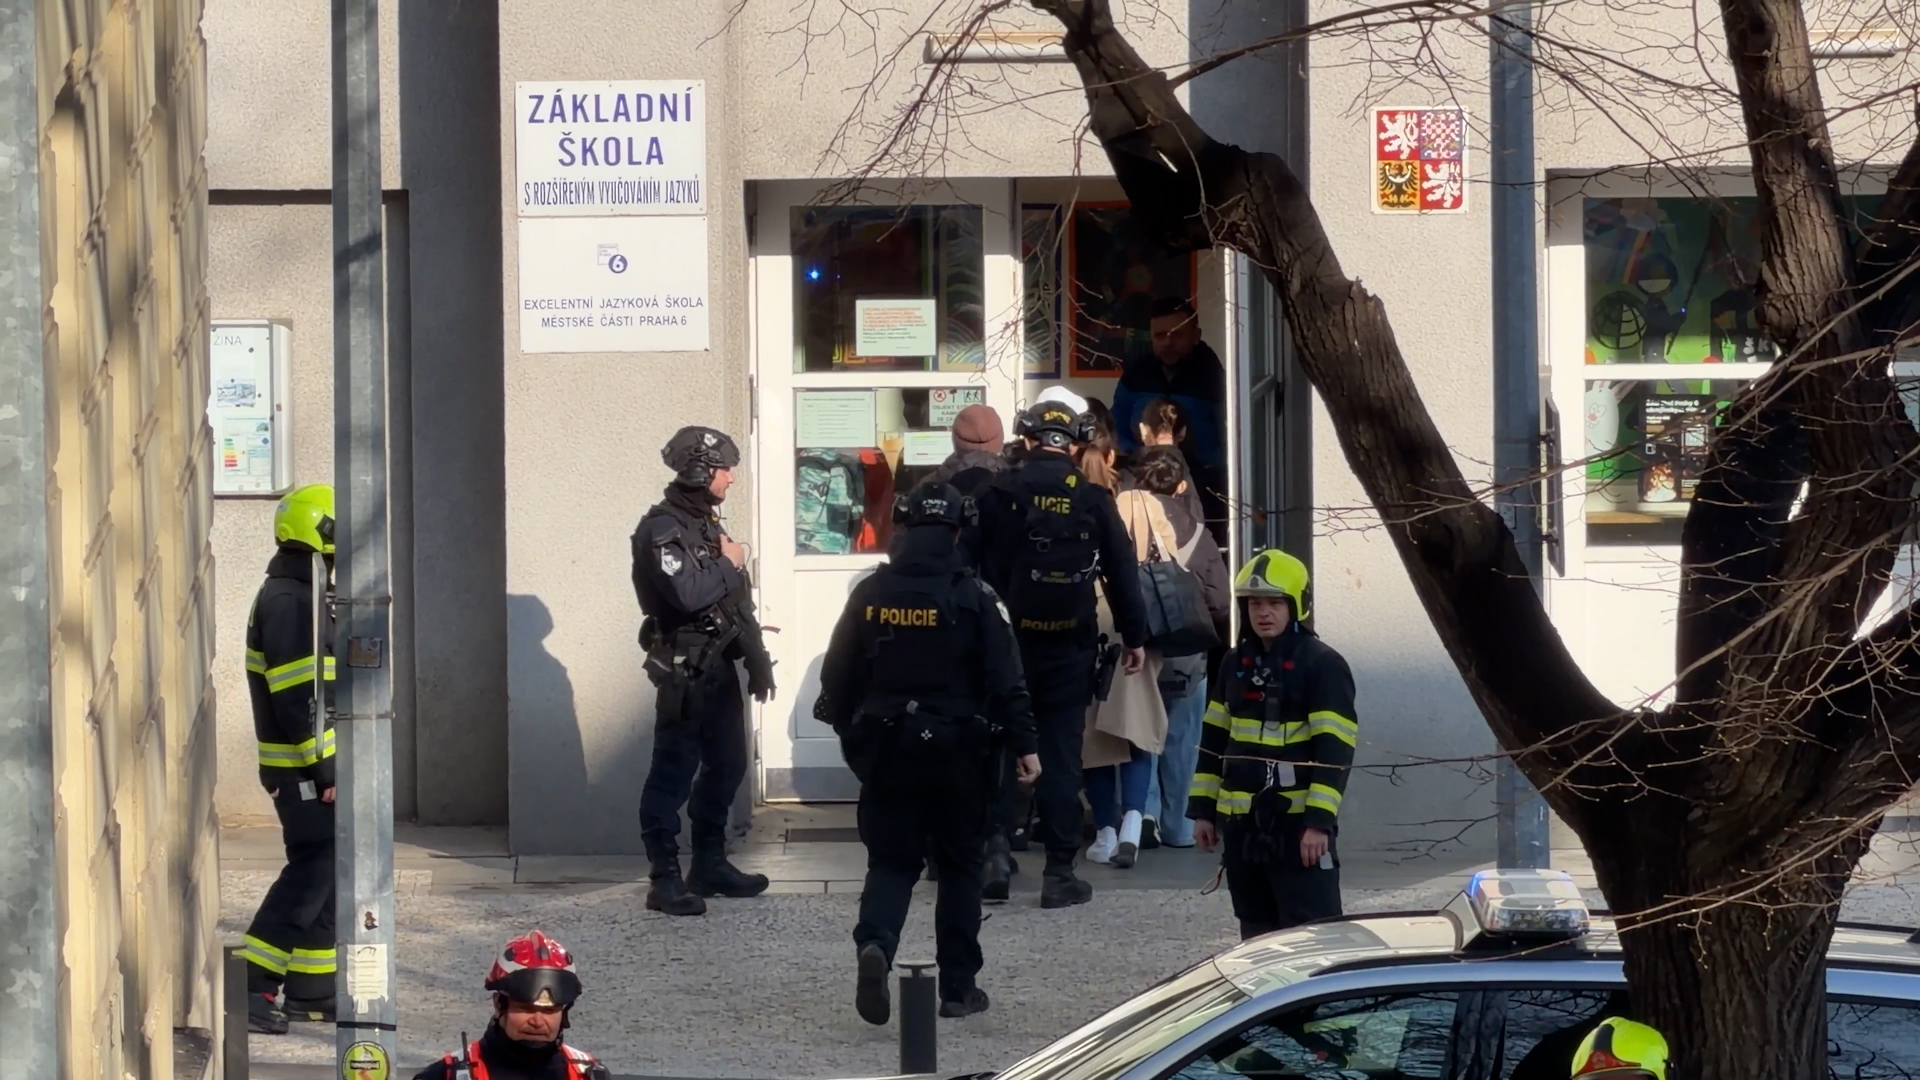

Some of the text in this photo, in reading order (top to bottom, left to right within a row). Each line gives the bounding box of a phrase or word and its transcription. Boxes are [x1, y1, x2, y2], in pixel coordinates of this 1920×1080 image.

[528, 86, 693, 124] ZÁKLADNÍ
[558, 131, 664, 167] ŠKOLA
[524, 173, 699, 206] S ROZŠÍŘENÝM VYUČOVÁNÍM JAZYKŮ
[612, 255, 625, 272] 6
[524, 294, 704, 310] EXCELENTNÍ JAZYKOVÁ ŠKOLA
[541, 313, 688, 328] MĚSTSKÉ ČÁSTI PRAHA 6
[880, 607, 938, 627] POLICIE
